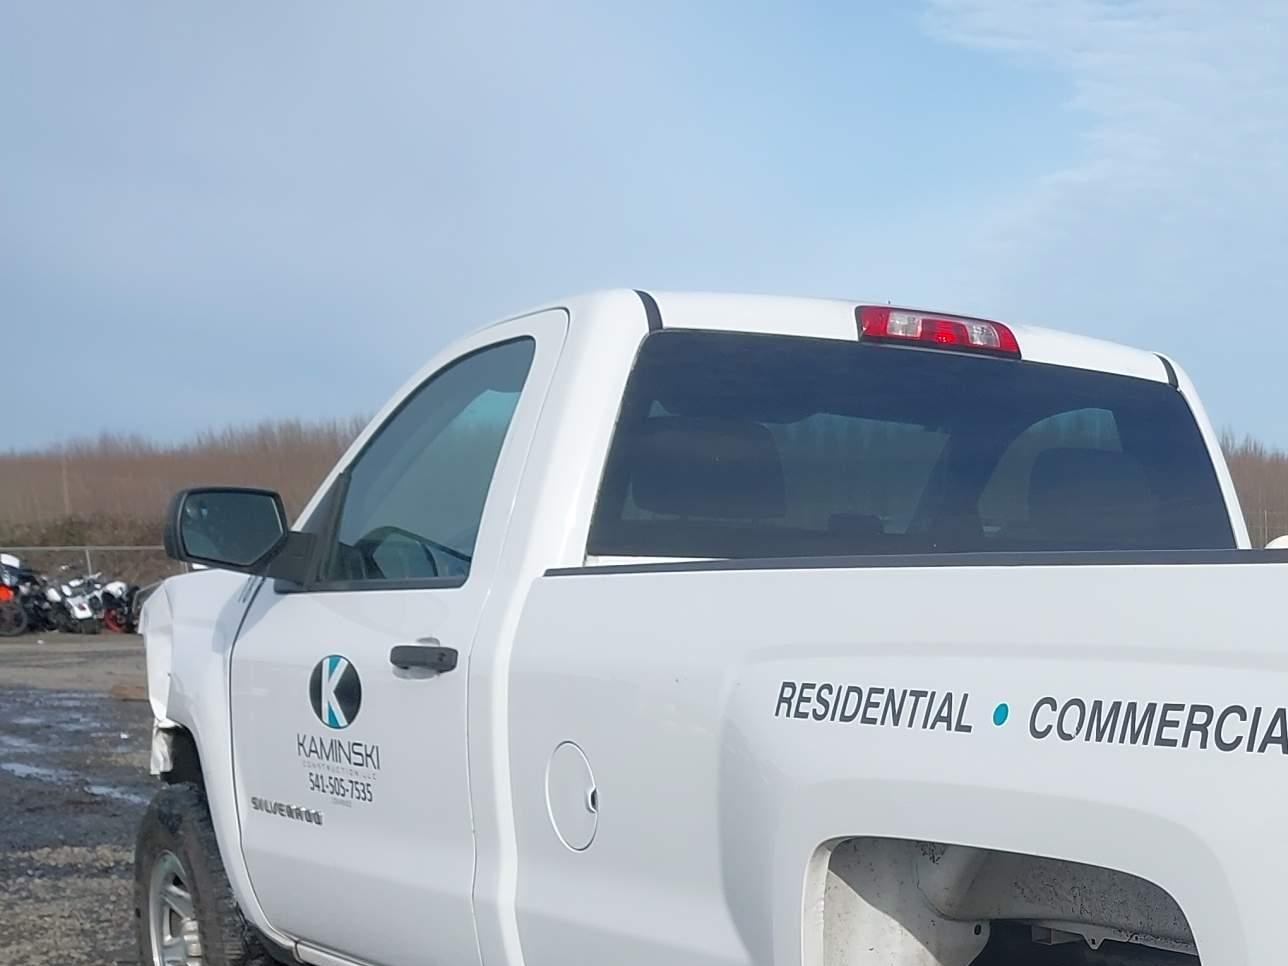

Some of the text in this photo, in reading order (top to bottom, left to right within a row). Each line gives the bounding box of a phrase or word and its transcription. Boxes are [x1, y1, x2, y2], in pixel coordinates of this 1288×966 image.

[774, 680, 973, 733] RESIDENTIAL
[297, 733, 381, 770] KAMINSKI
[309, 772, 373, 802] 541-505-7535
[251, 796, 323, 826] SILVERADO
